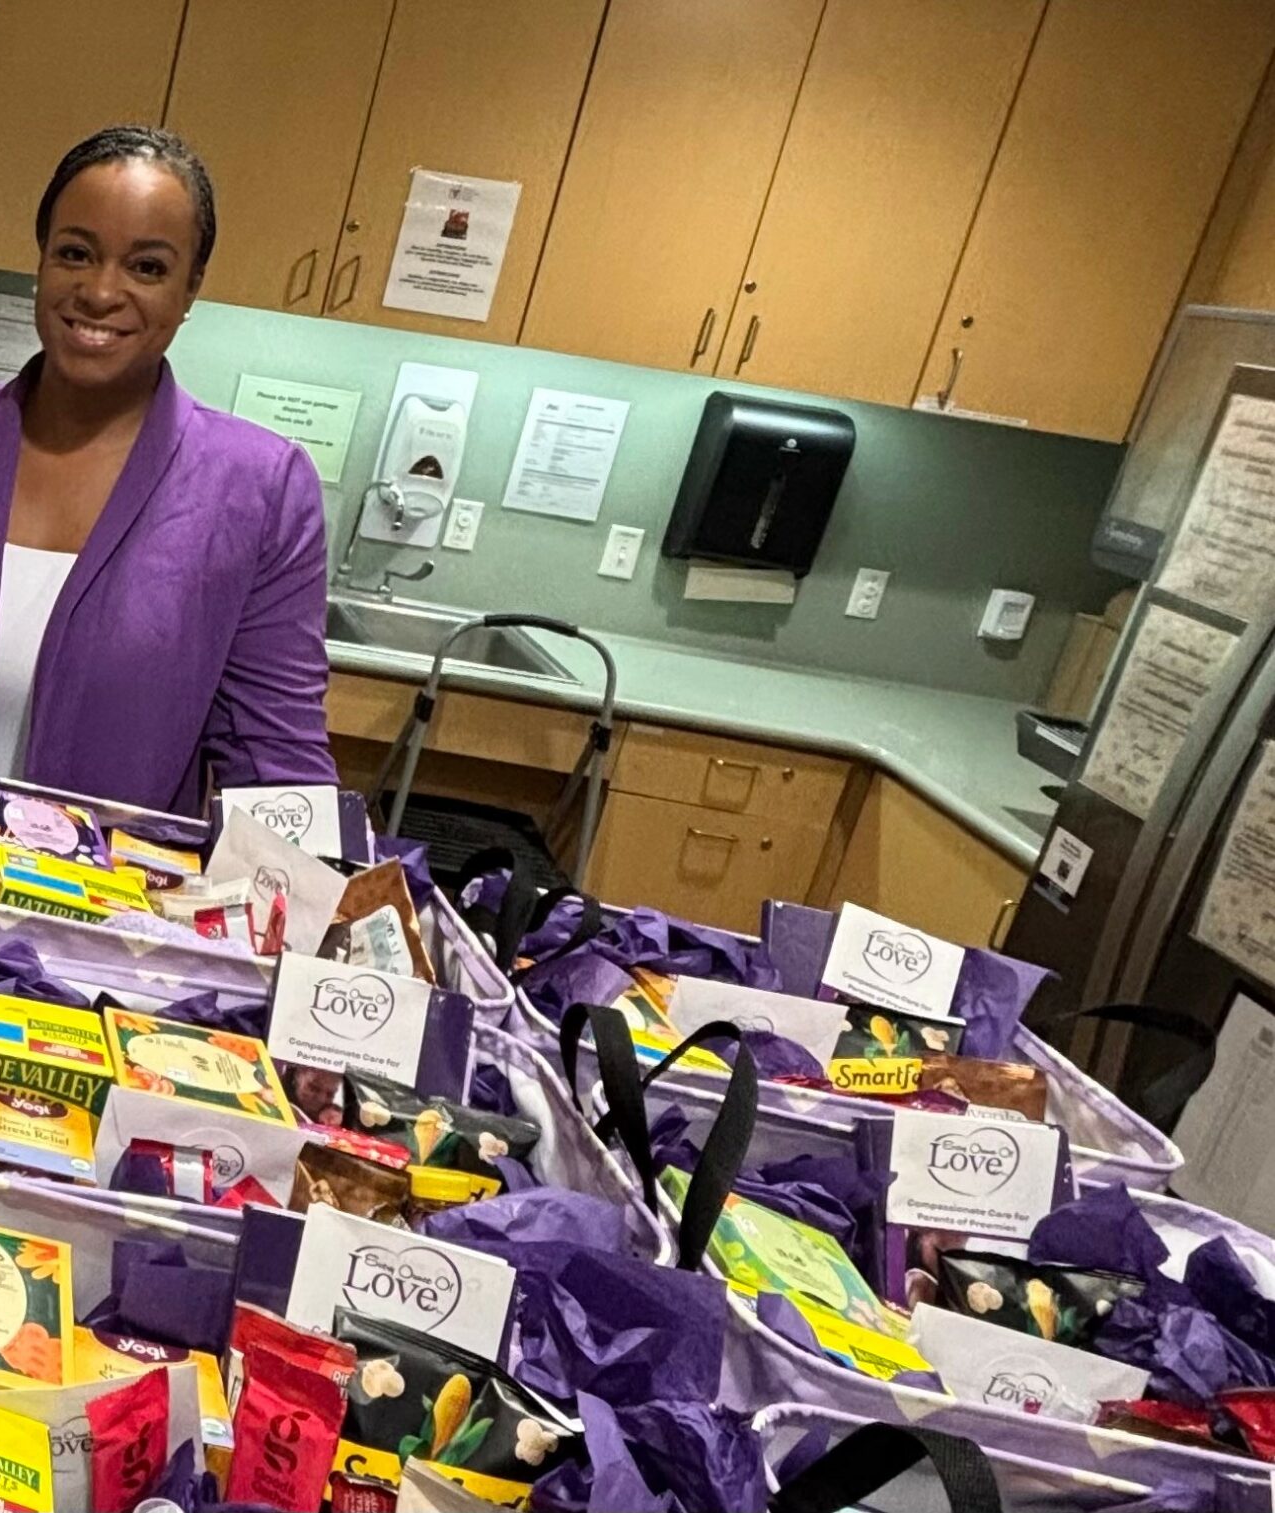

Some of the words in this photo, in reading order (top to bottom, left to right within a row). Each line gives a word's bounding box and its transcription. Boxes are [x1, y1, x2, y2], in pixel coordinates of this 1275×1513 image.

[864, 934, 918, 972] Love
[310, 984, 379, 1021] Love
[289, 1037, 362, 1059] Compassionate
[363, 1053, 385, 1065] Care
[386, 1058, 400, 1068] for
[297, 1050, 332, 1066] Parents
[333, 1059, 344, 1067] of
[20, 1062, 105, 1109] VALLEY
[835, 1064, 922, 1088] Smartfo
[12, 1097, 52, 1115] yogi
[928, 1143, 1003, 1175] Love
[907, 1198, 987, 1217] Compassionate
[988, 1209, 1013, 1219] Care
[1014, 1211, 1030, 1221] for
[917, 1213, 955, 1225] Parents
[956, 1216, 968, 1225] of
[969, 1219, 1018, 1232] Preemies
[342, 1253, 439, 1312] Love
[116, 1338, 169, 1360] yogi
[51, 1437, 94, 1457] ove
